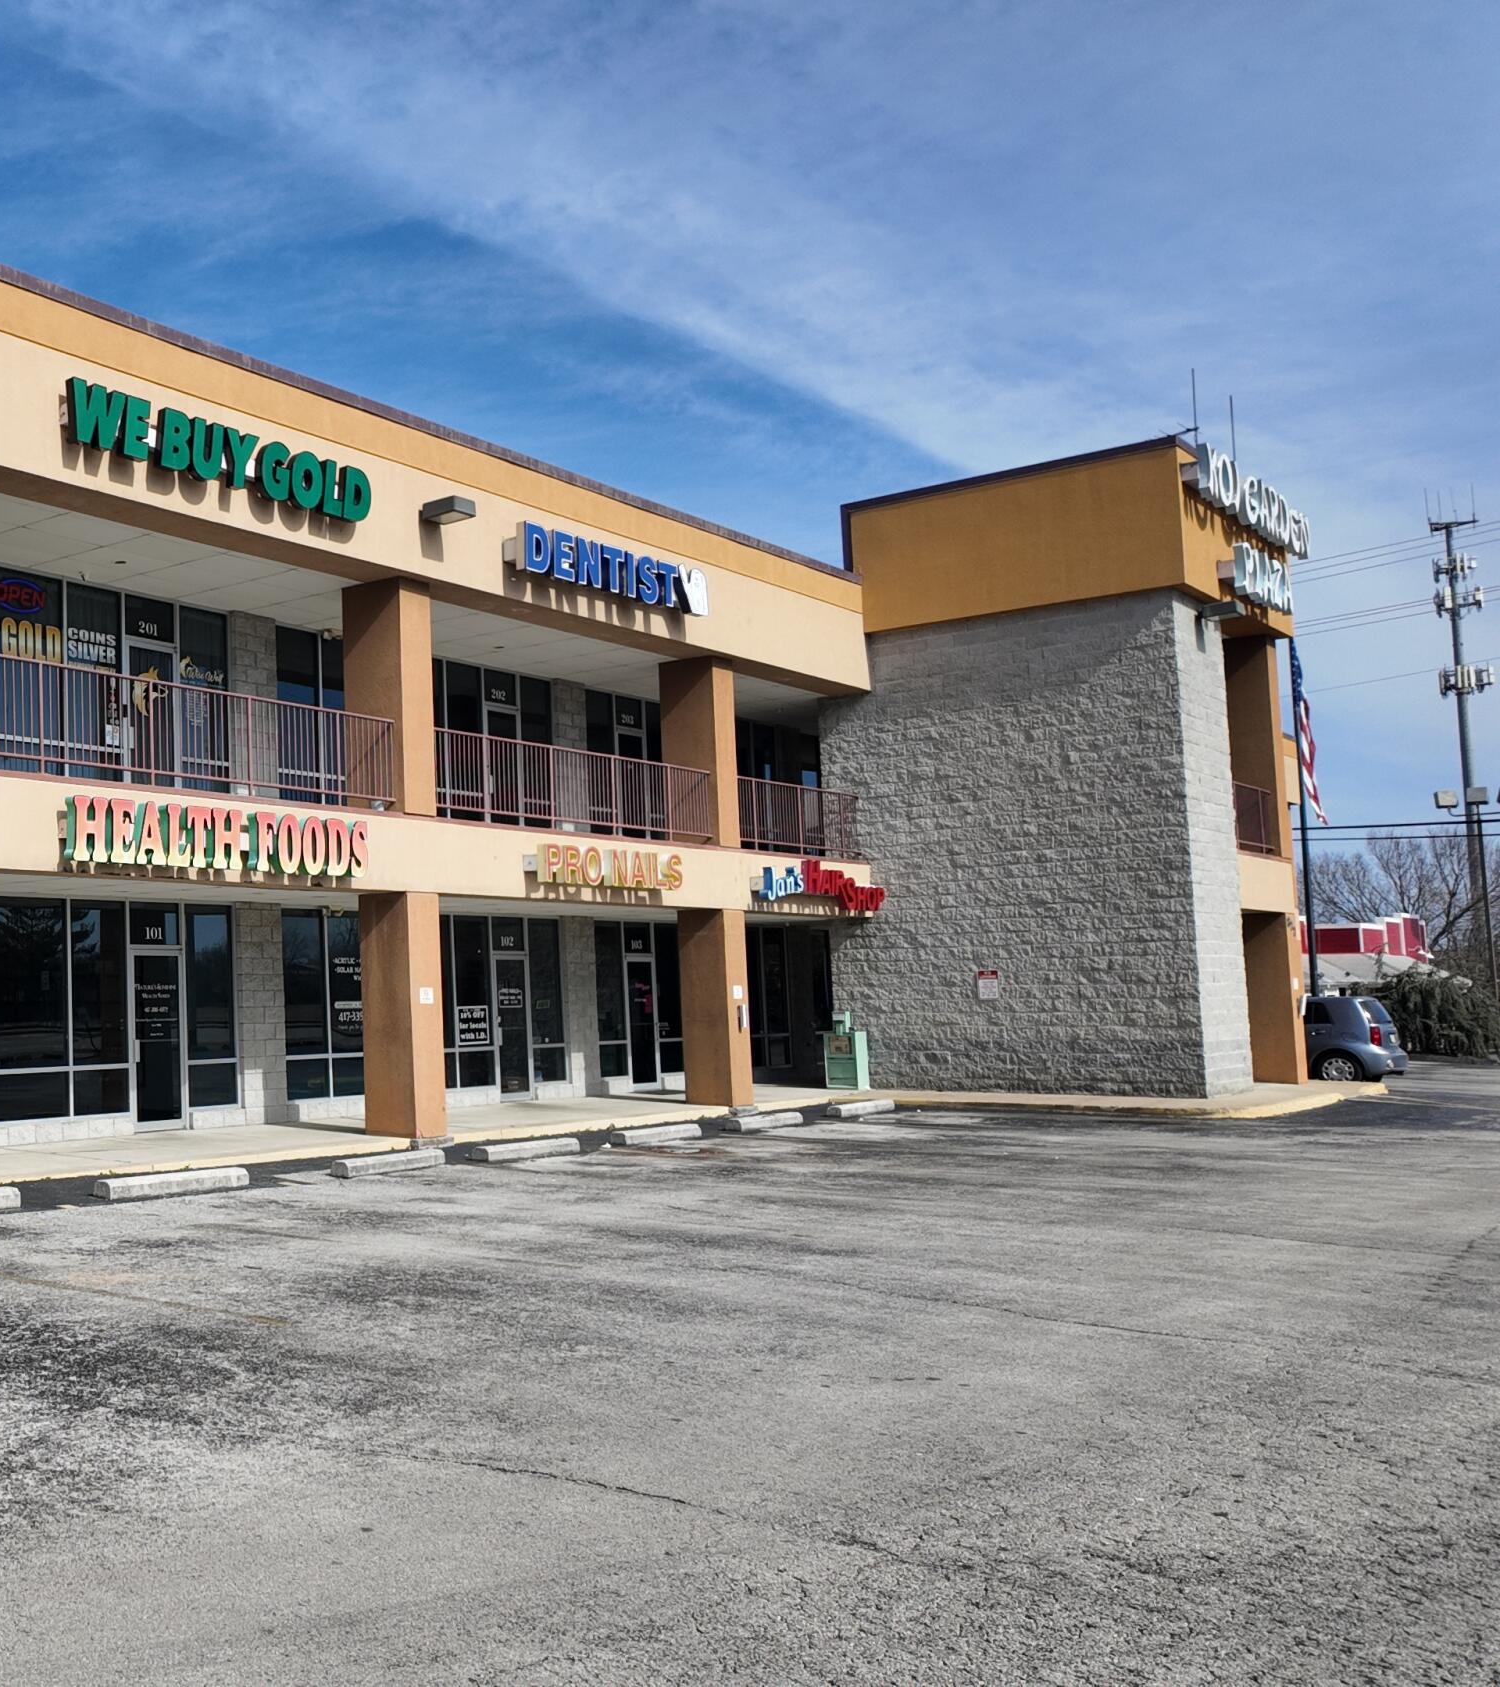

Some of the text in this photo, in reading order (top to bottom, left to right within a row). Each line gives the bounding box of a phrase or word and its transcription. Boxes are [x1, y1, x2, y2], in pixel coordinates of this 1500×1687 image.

[65, 376, 372, 523] WE BUY GOLD
[1243, 476, 1310, 558] GARDEN
[520, 520, 680, 609] DENTIST
[1238, 541, 1294, 614] PLAZA
[1, 617, 63, 665] GOLD
[67, 627, 117, 647] COINS
[138, 621, 158, 637] 201
[491, 689, 506, 701] 202
[67, 794, 369, 879] HEALTH FOODS
[540, 843, 683, 891] PRO NAILS
[762, 860, 885, 912] Jan's HAIR SHOP
[144, 926, 163, 940] 101
[501, 936, 514, 947] 102
[630, 940, 643, 950] 103
